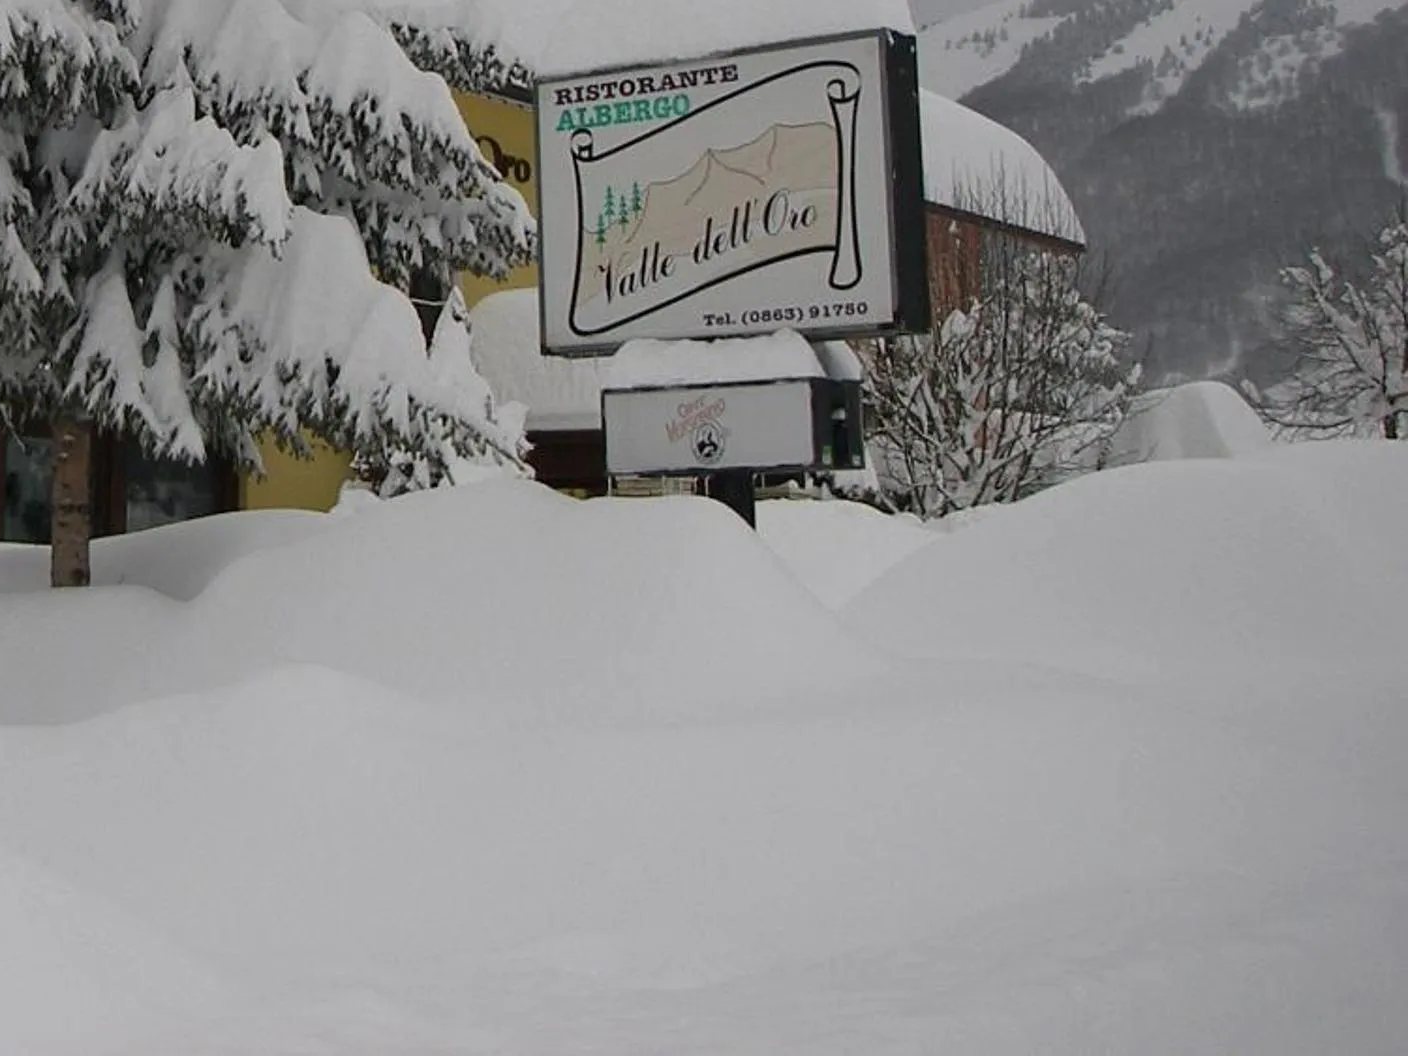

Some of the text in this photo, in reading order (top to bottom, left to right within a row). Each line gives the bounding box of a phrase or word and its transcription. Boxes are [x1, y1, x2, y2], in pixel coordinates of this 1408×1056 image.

[554, 64, 739, 106] RISTORANTE
[556, 94, 691, 132] ALBERGO
[596, 187, 818, 304] Valle dell'Oro
[703, 301, 869, 326] Tel. (0863) 91750
